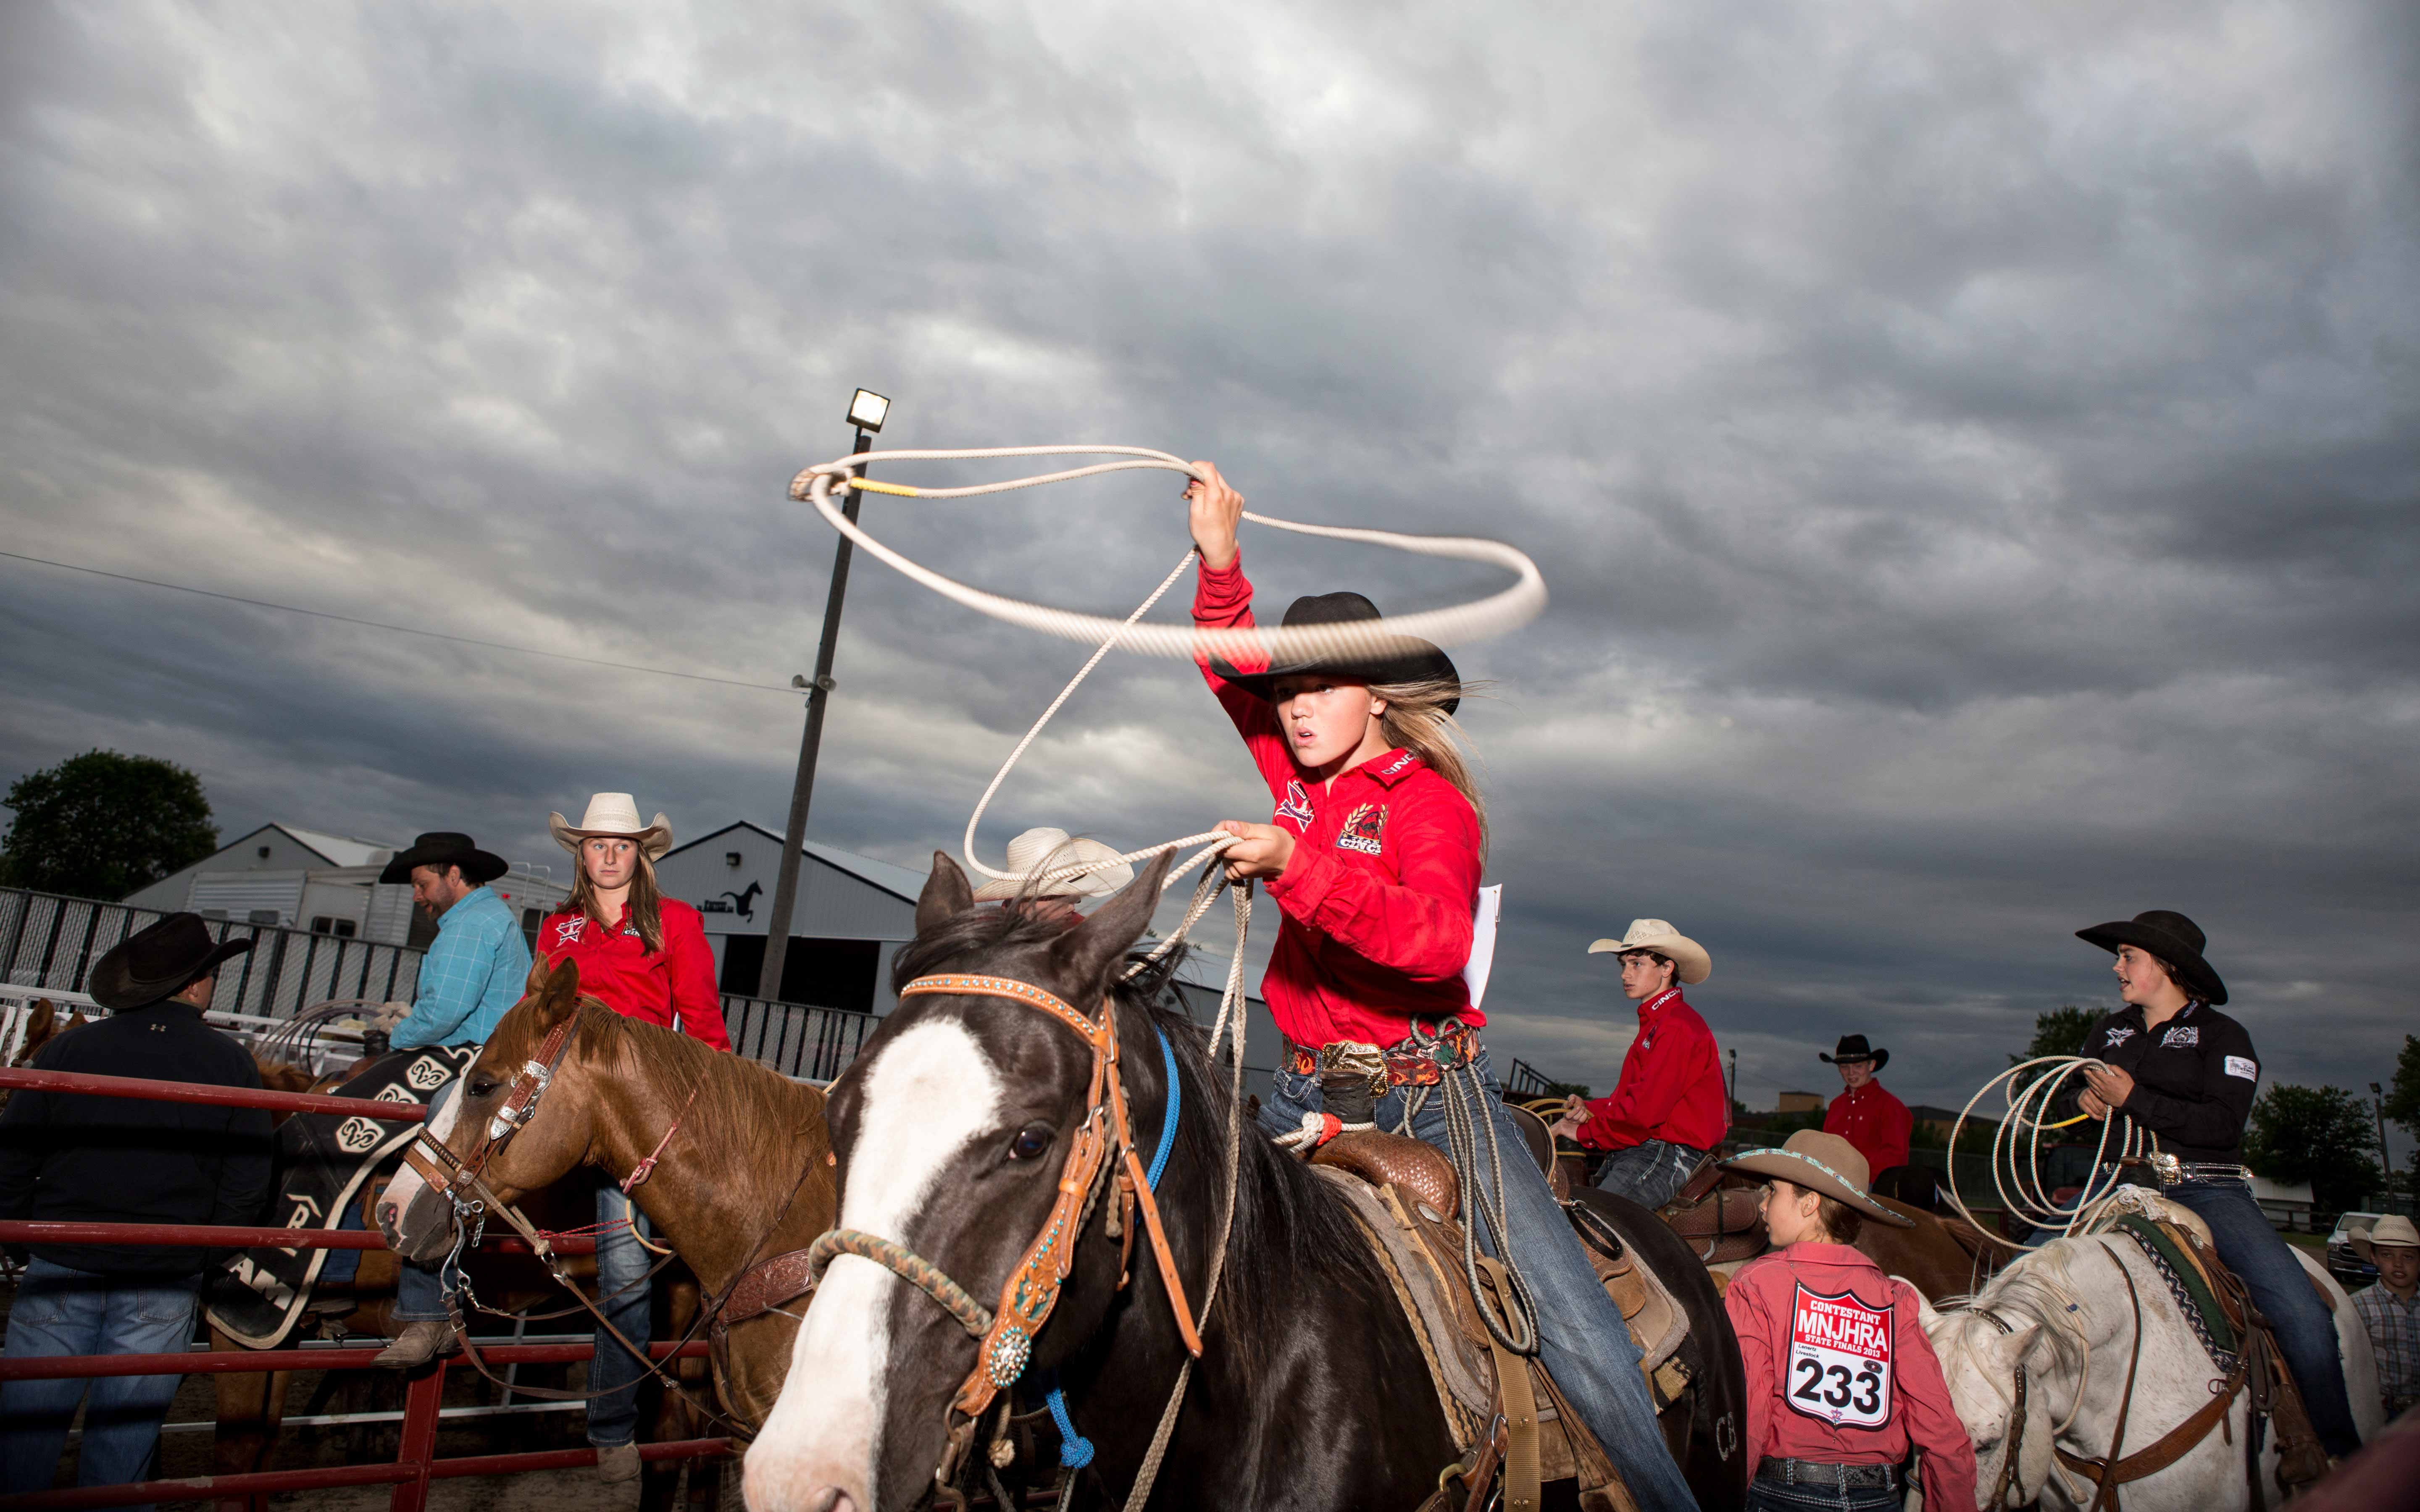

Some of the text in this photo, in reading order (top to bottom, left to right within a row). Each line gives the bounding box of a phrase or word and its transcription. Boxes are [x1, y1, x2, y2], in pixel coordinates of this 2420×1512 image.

[1381, 753, 1415, 774] CINC
[1652, 989, 1681, 1010] CINCH
[221, 1252, 295, 1311] AM
[1810, 1300, 1881, 1325] CONTESTANT
[1798, 1309, 1888, 1352] MNJHRA
[1796, 1349, 1819, 1358] Livestock
[1805, 1334, 1881, 1358] STATE FINALS 2013
[1793, 1358, 1881, 1415] 233
